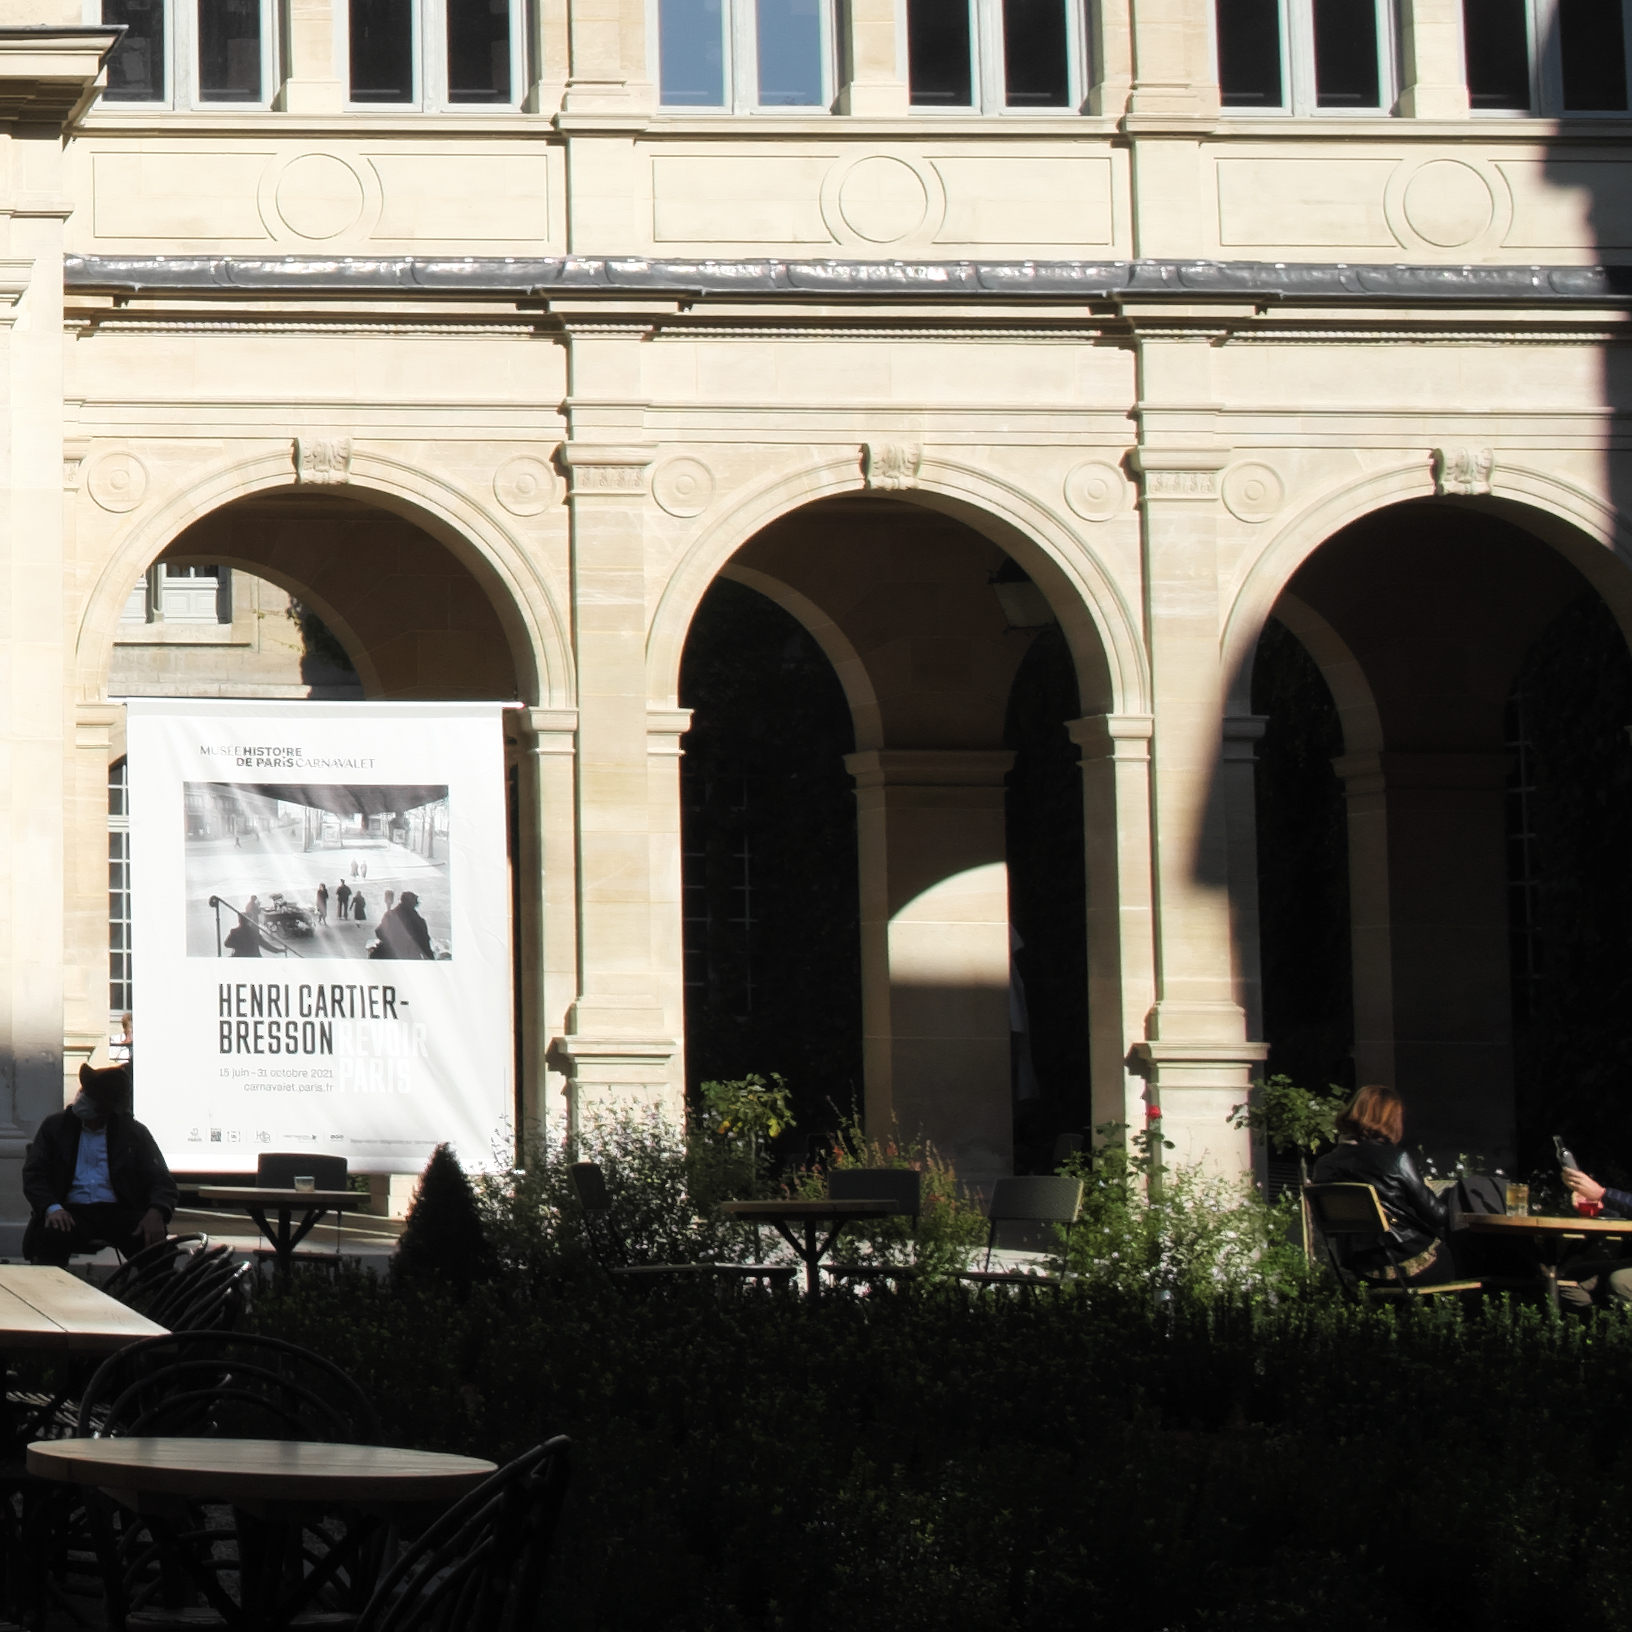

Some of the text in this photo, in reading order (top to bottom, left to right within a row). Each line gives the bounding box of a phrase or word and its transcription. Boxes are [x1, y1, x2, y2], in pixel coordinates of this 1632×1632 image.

[236, 758, 253, 767] DE
[295, 758, 376, 769] CARNAVALET
[219, 983, 409, 1019] HENRI CARTIER-
[219, 1020, 429, 1058] BRESSON REVOIR
[231, 1068, 249, 1079] juin
[270, 1068, 308, 1078] octobre
[310, 1068, 334, 1078] 2021
[339, 1057, 412, 1094] PARIS
